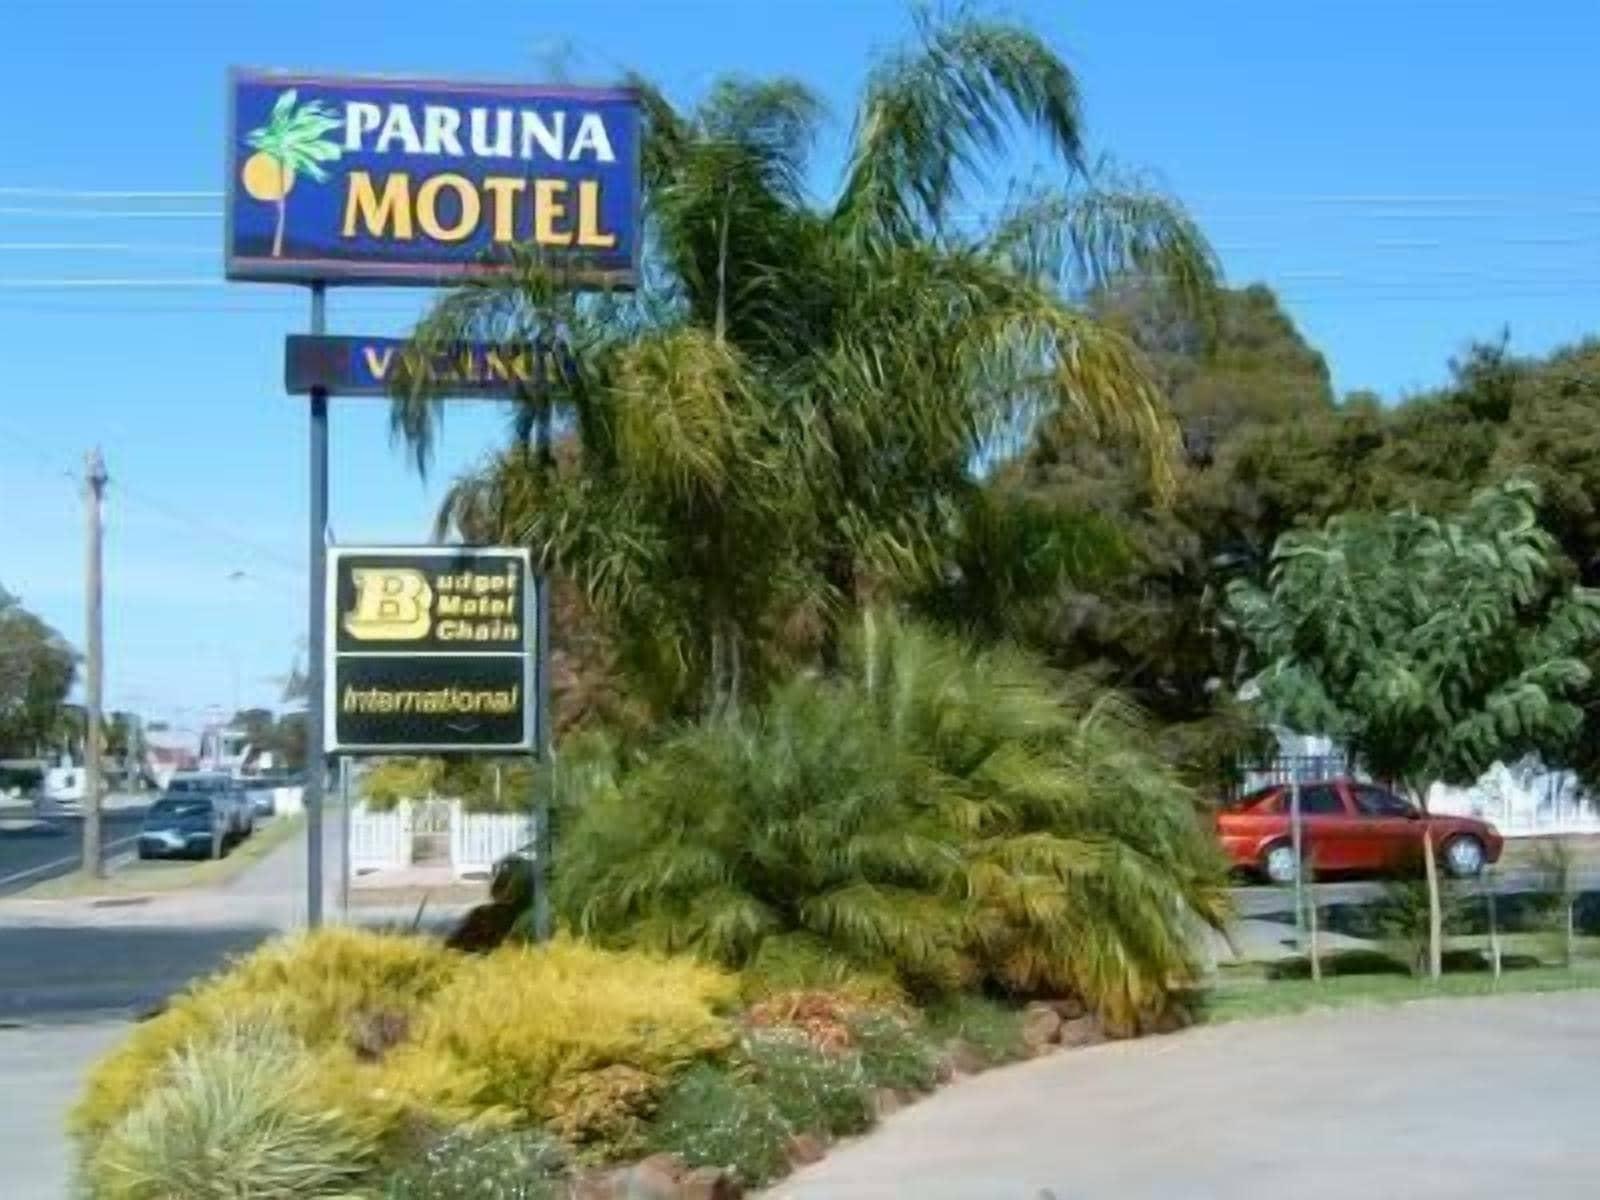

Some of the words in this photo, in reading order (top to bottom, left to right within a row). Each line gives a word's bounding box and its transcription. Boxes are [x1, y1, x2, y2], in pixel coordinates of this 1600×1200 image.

[344, 101, 616, 162] PARUNA
[341, 171, 617, 247] MOTEL
[437, 595, 515, 615] Motel
[436, 620, 518, 641] Chain
[343, 684, 518, 714] International
